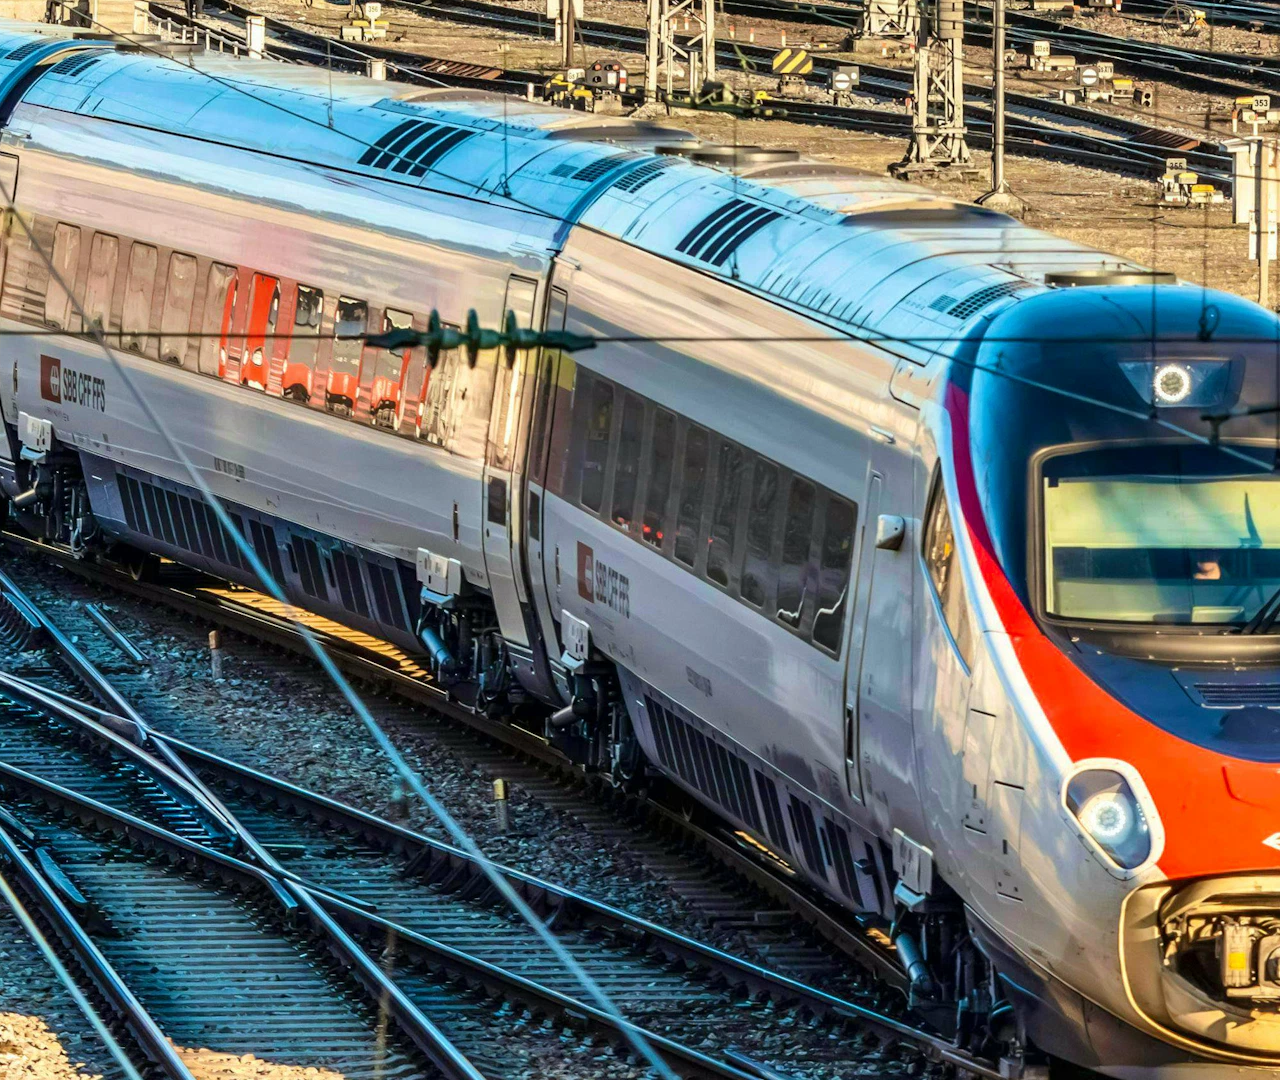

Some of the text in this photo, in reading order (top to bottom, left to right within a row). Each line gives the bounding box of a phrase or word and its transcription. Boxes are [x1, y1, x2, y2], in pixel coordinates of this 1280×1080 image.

[1255, 99, 1268, 107] 353
[63, 367, 106, 413] SBB CFF FFS
[596, 560, 607, 604] SBB
[608, 566, 618, 612] CFF
